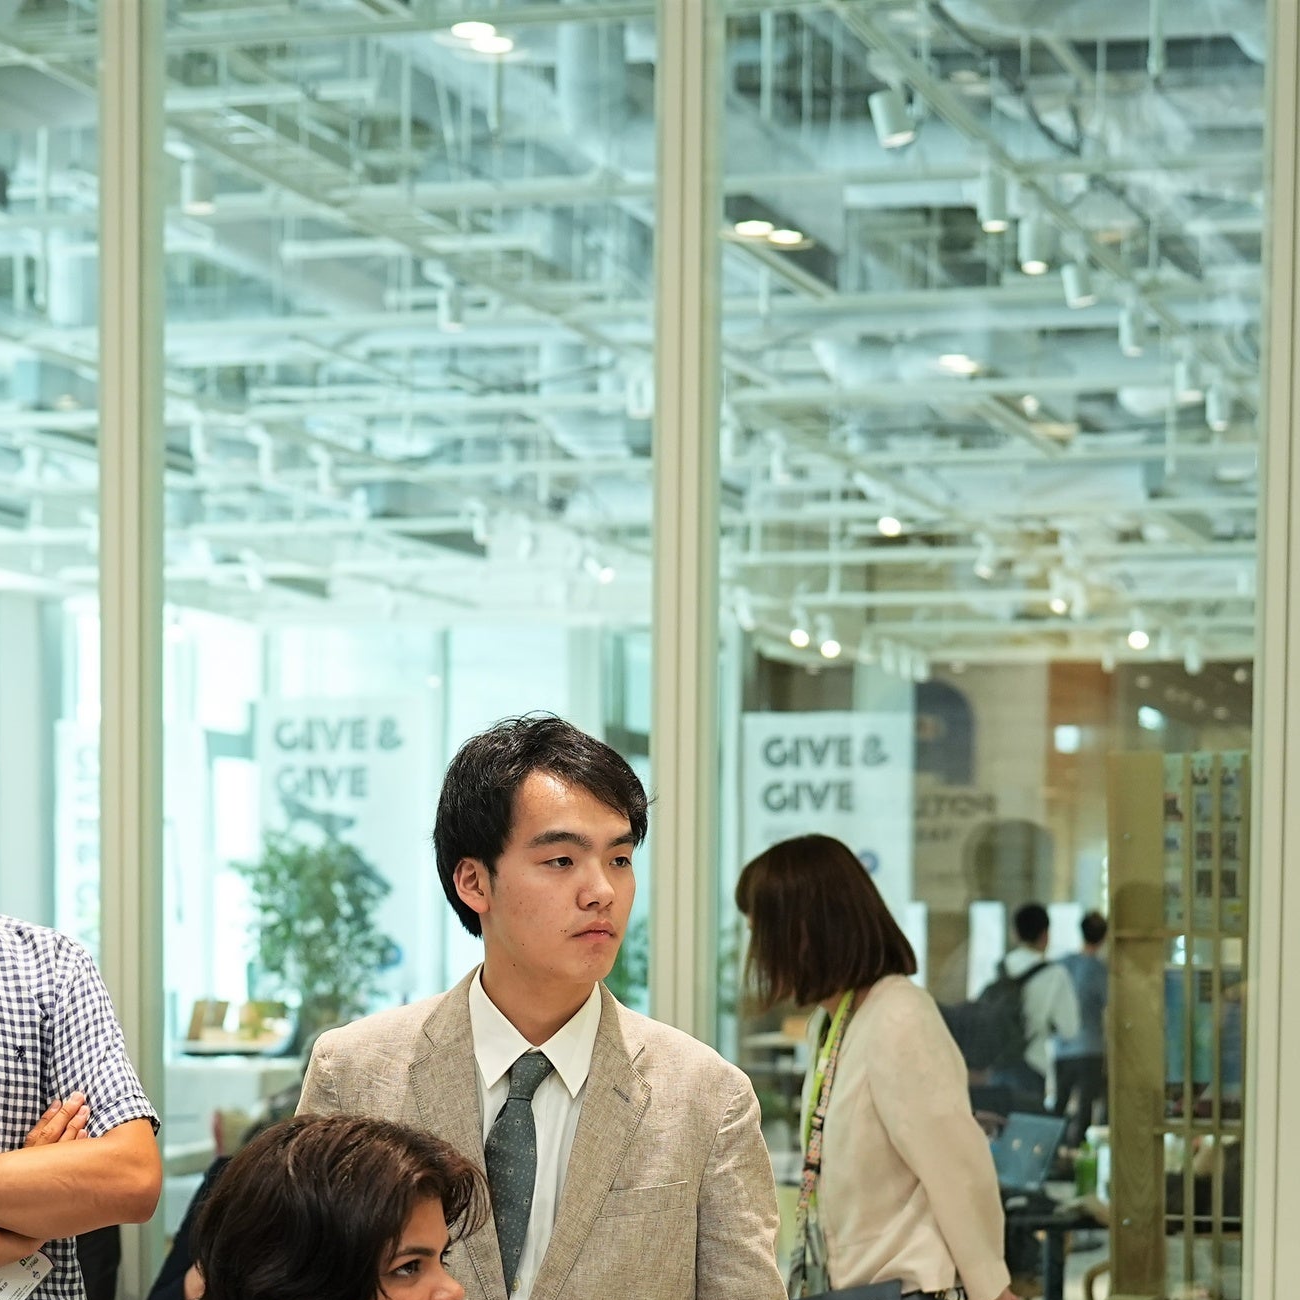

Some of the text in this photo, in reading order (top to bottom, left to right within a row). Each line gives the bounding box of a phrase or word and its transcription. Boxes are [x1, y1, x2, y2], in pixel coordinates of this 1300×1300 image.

[274, 716, 403, 751] GIVE &
[763, 734, 890, 768] GIVE &
[276, 766, 367, 798] GIVE
[763, 780, 854, 812] GIVE
